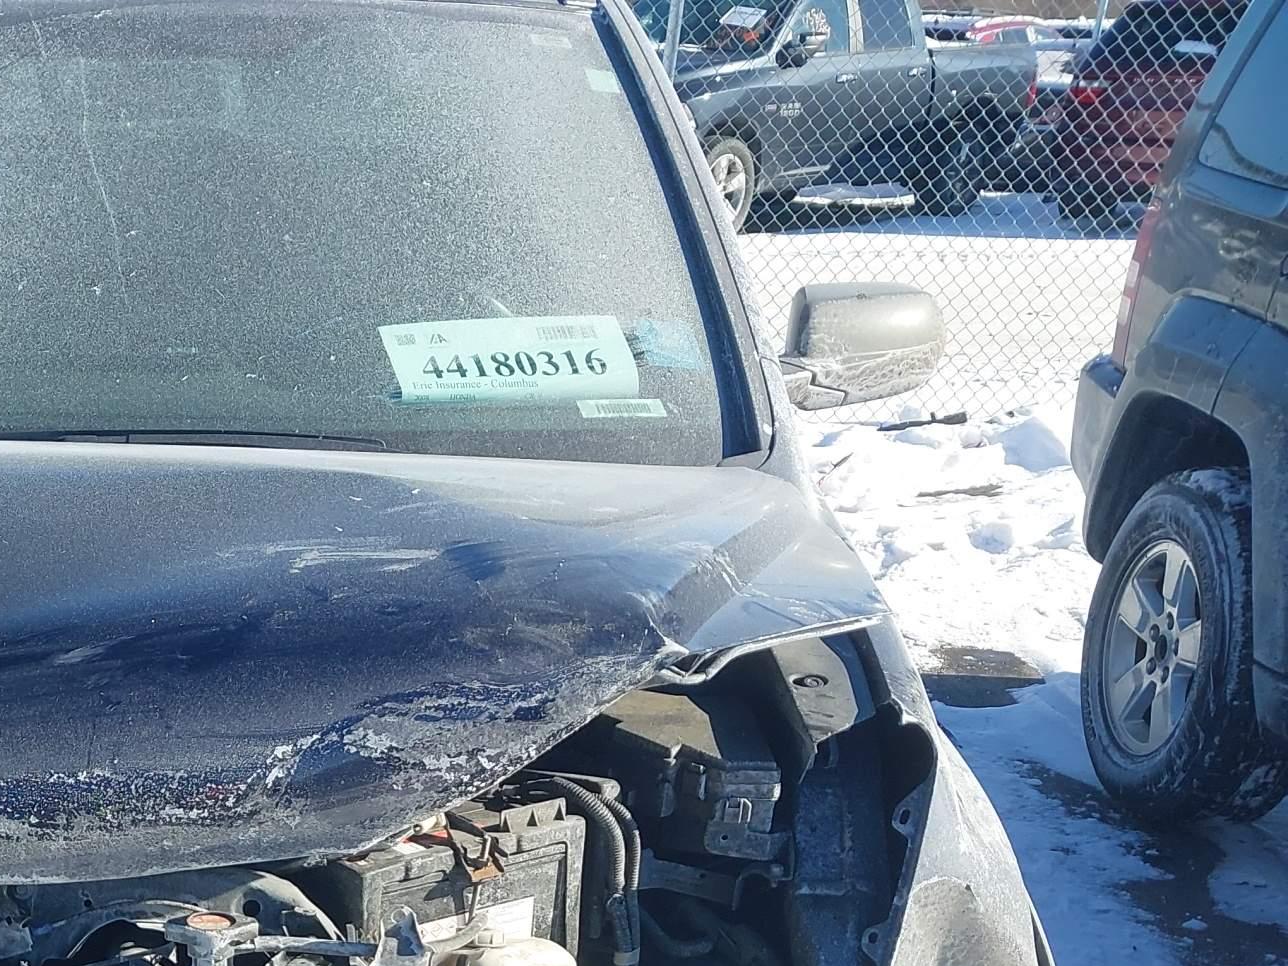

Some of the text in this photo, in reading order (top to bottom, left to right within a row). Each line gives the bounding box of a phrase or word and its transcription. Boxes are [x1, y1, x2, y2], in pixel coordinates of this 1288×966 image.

[422, 348, 608, 379] 44180316
[436, 381, 482, 389] Insurance
[491, 379, 539, 388] Columbus
